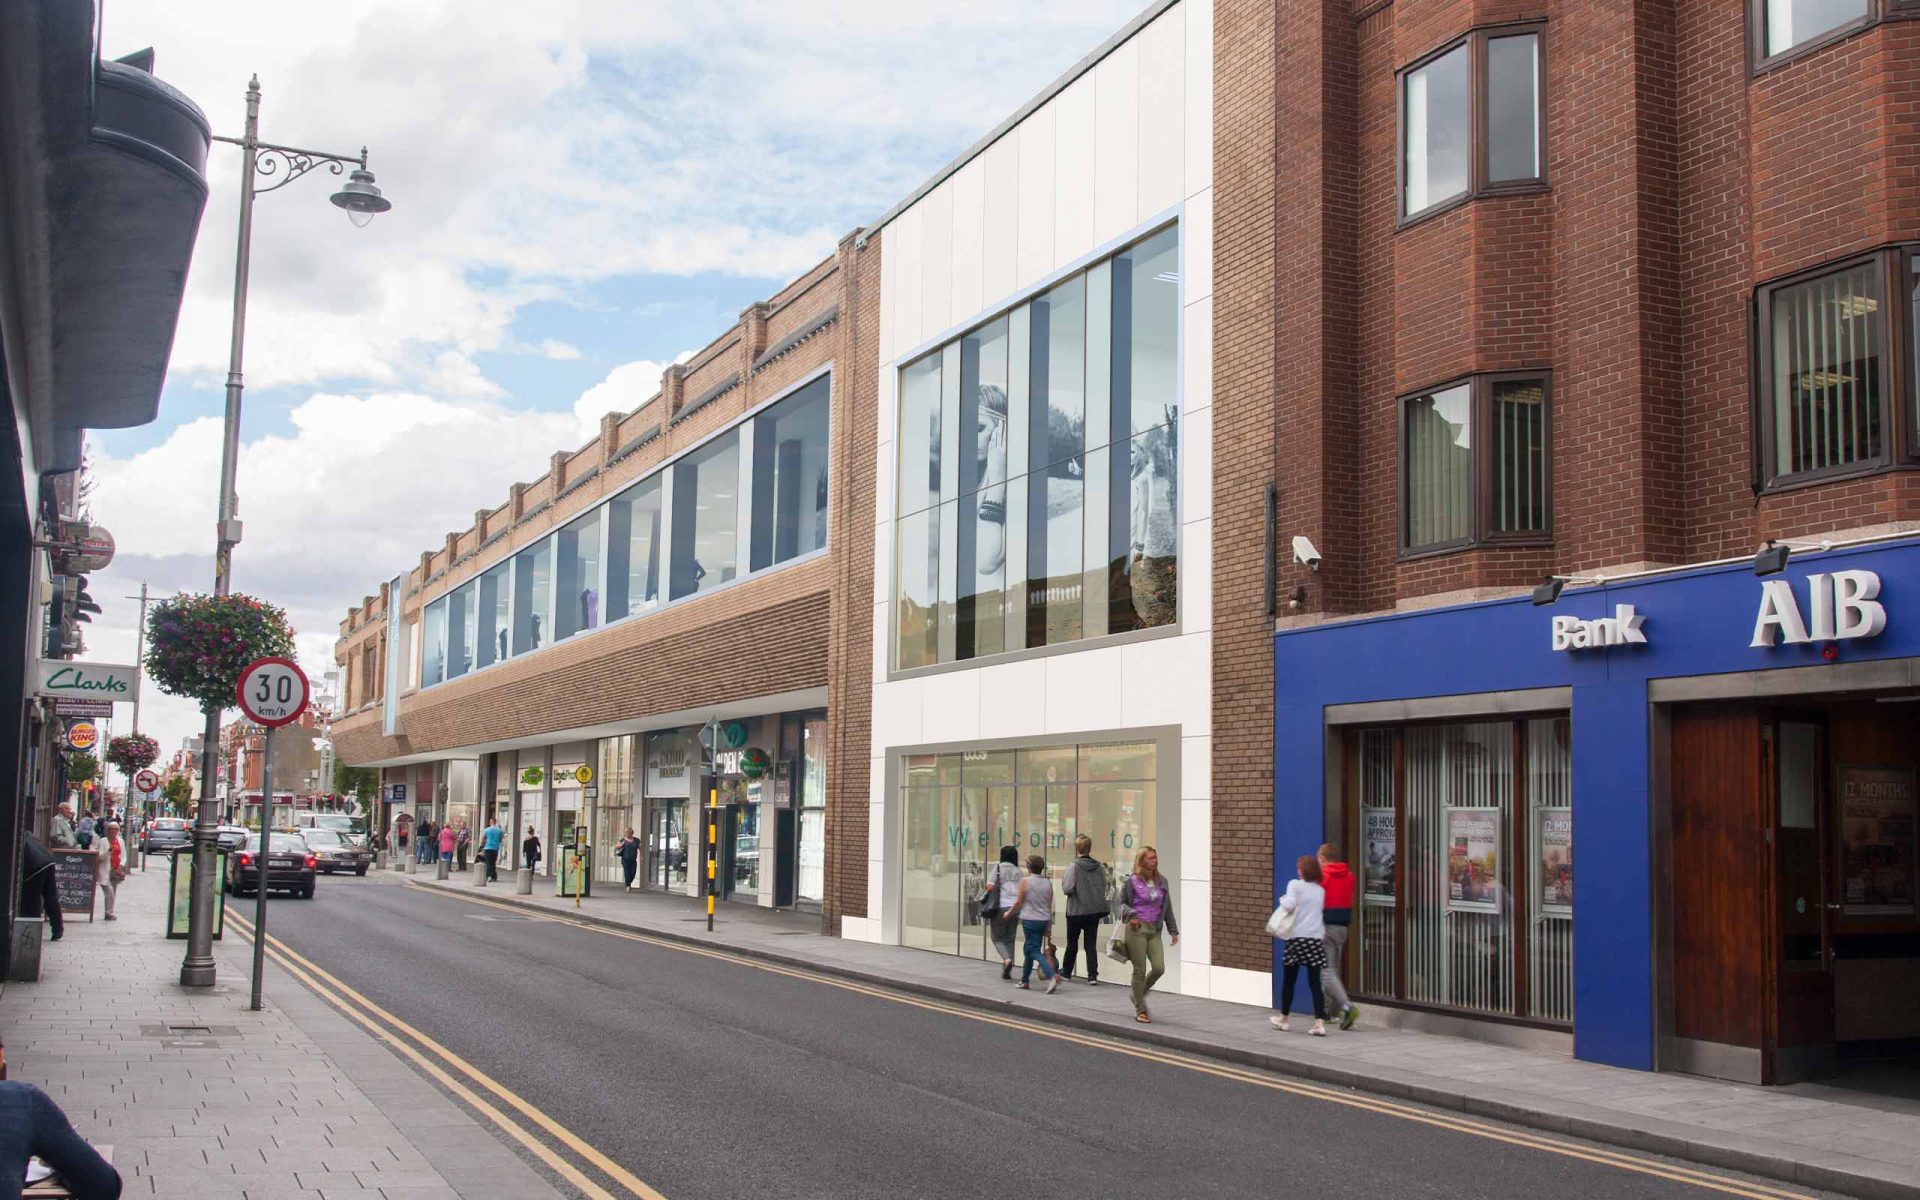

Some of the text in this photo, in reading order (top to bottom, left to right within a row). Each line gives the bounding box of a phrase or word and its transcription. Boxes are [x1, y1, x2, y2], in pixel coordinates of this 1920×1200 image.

[1749, 569, 1887, 648] AIB
[1552, 603, 1648, 651] Bank
[46, 667, 127, 692] Clarks
[256, 674, 292, 703] 30
[258, 706, 286, 716] km/h
[70, 733, 95, 741] KING
[1367, 816, 1377, 828] 48
[1544, 820, 1553, 831] 12
[1110, 829, 1133, 849] to
